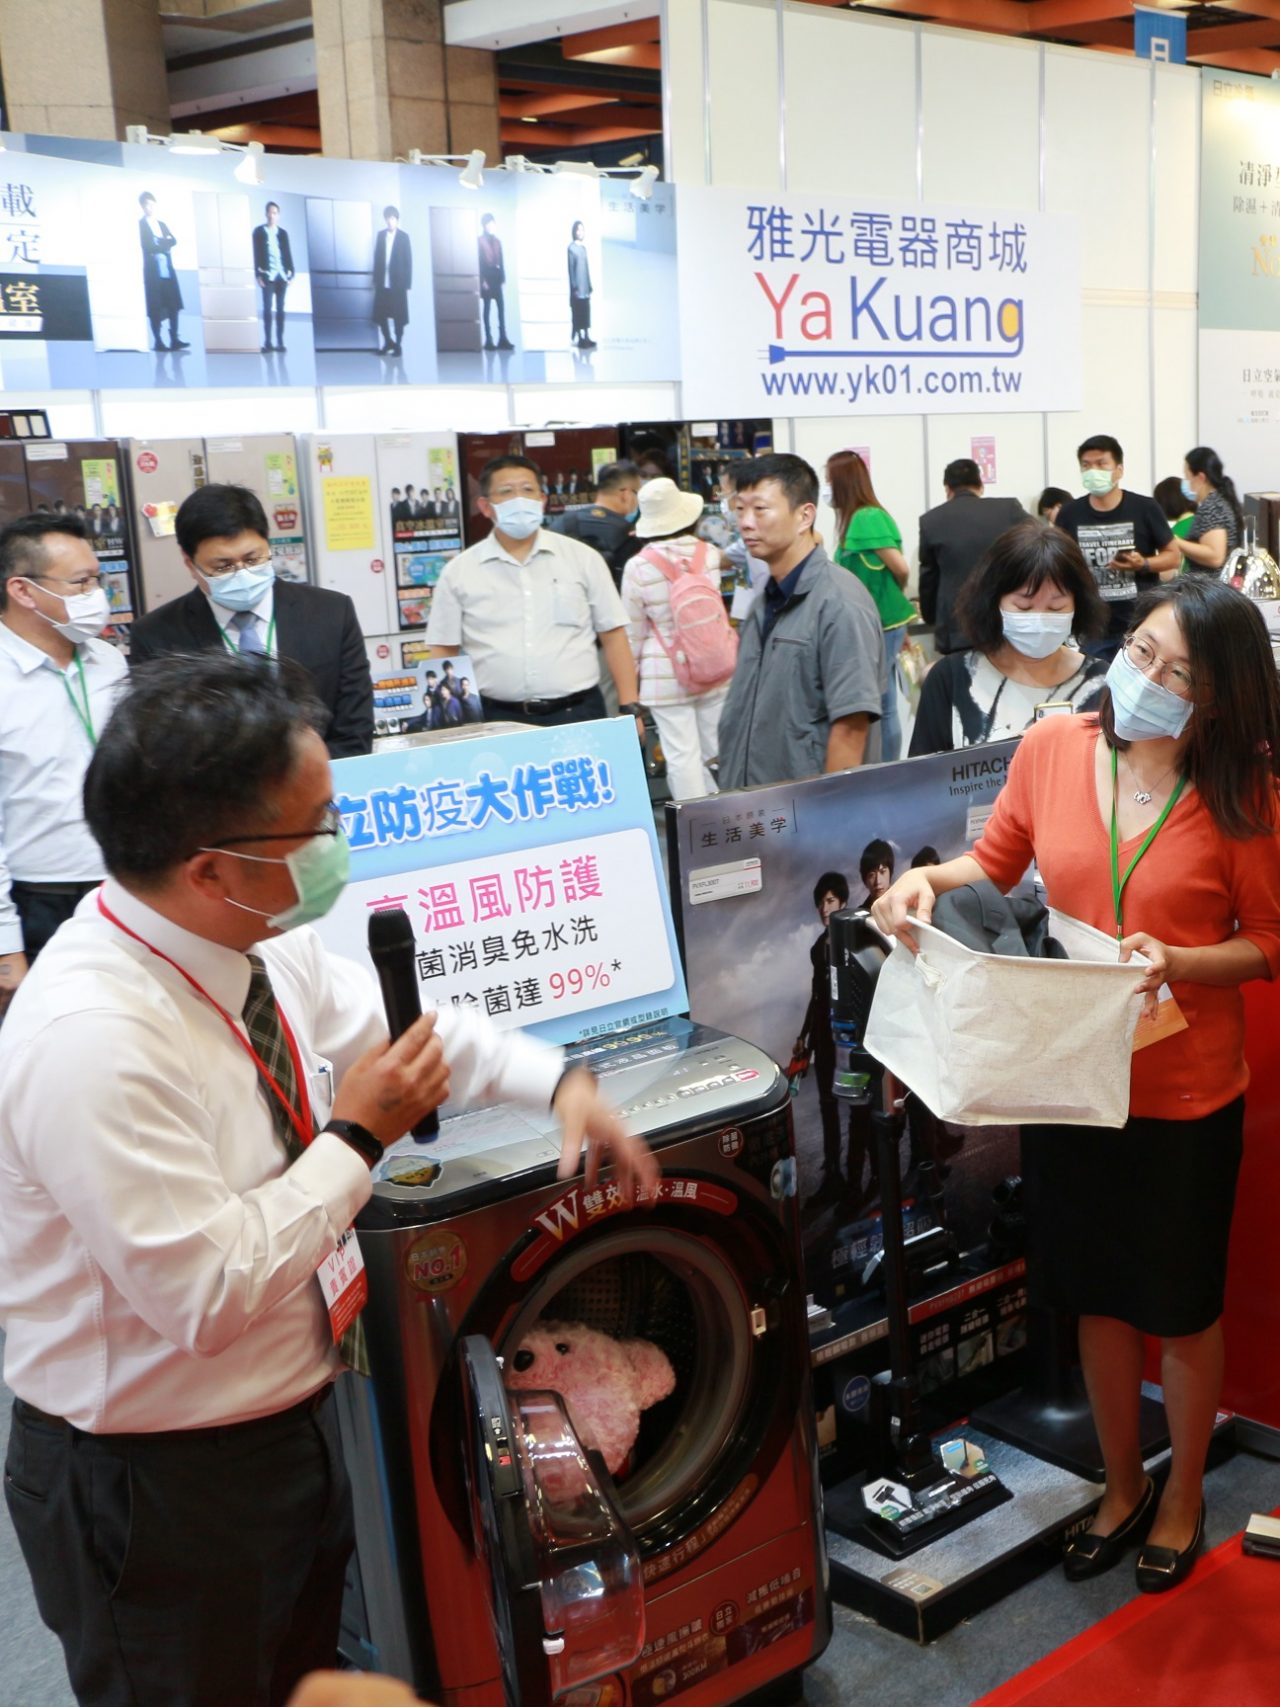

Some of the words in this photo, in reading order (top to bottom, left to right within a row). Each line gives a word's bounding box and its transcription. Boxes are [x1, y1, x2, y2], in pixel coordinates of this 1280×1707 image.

[746, 205, 1028, 273] 雅光電器商城
[0, 281, 43, 314] 室
[753, 272, 833, 341] Ya
[849, 276, 1025, 357] Kuang
[760, 364, 1023, 402] www.yk01.com.tw
[952, 754, 1014, 782] HITACH
[948, 781, 984, 797] Inspire
[985, 776, 1001, 789] the
[701, 816, 787, 848] 生活美学
[413, 1243, 463, 1281] NO.1
